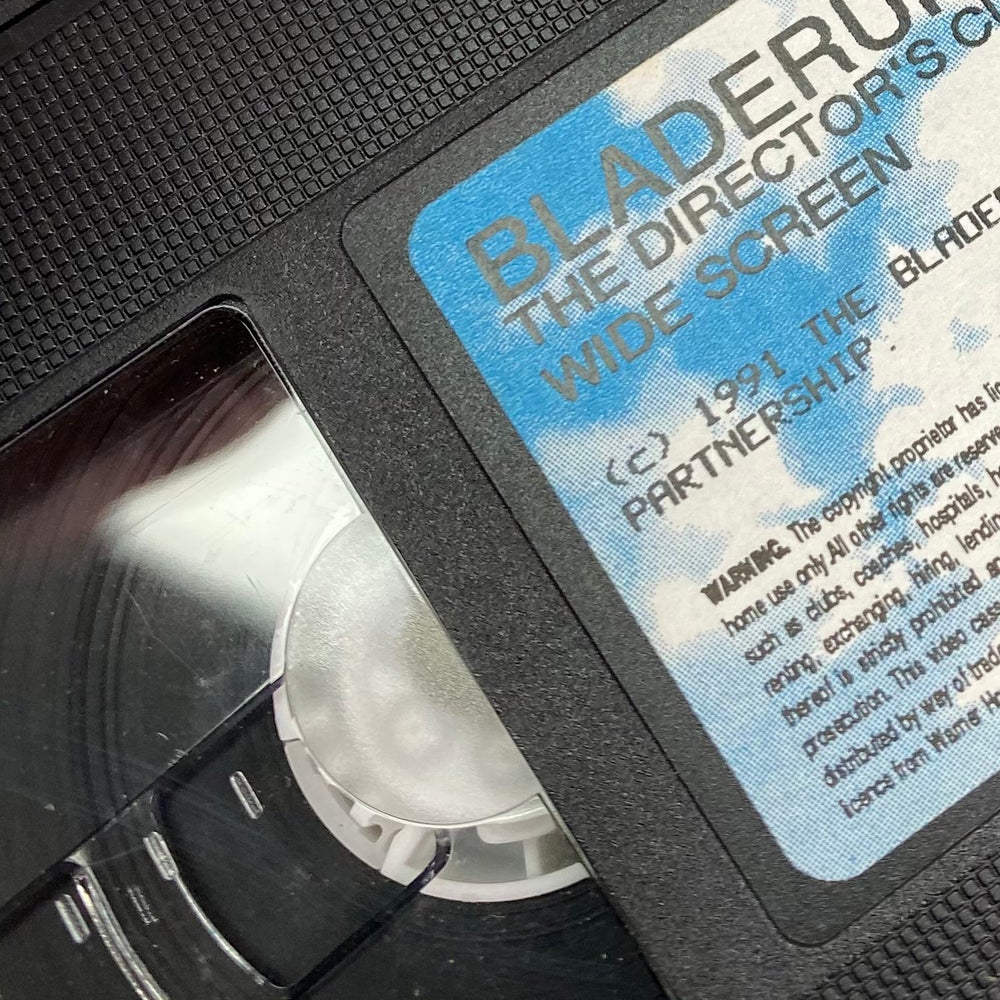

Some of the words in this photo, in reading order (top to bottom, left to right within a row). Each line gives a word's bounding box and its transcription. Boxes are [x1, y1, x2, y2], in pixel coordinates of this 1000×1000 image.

[501, 248, 630, 346] THE
[625, 36, 949, 271] DIRECTOR'S
[539, 279, 693, 402] WIDE
[694, 132, 913, 300] SCREEN
[605, 430, 670, 487] (c)
[694, 349, 786, 427] 1991
[799, 283, 878, 345] THE
[785, 515, 822, 543] The
[820, 462, 893, 523] copyright
[888, 414, 959, 478] proprietor
[954, 395, 988, 424] has
[719, 599, 768, 638] home
[765, 578, 797, 607] use
[743, 630, 783, 666] such
[804, 584, 855, 622] clubs,
[914, 482, 992, 539] hospitals,
[885, 659, 927, 690] This
[925, 628, 968, 665] video
[893, 707, 922, 733] by
[951, 665, 971, 693] of
